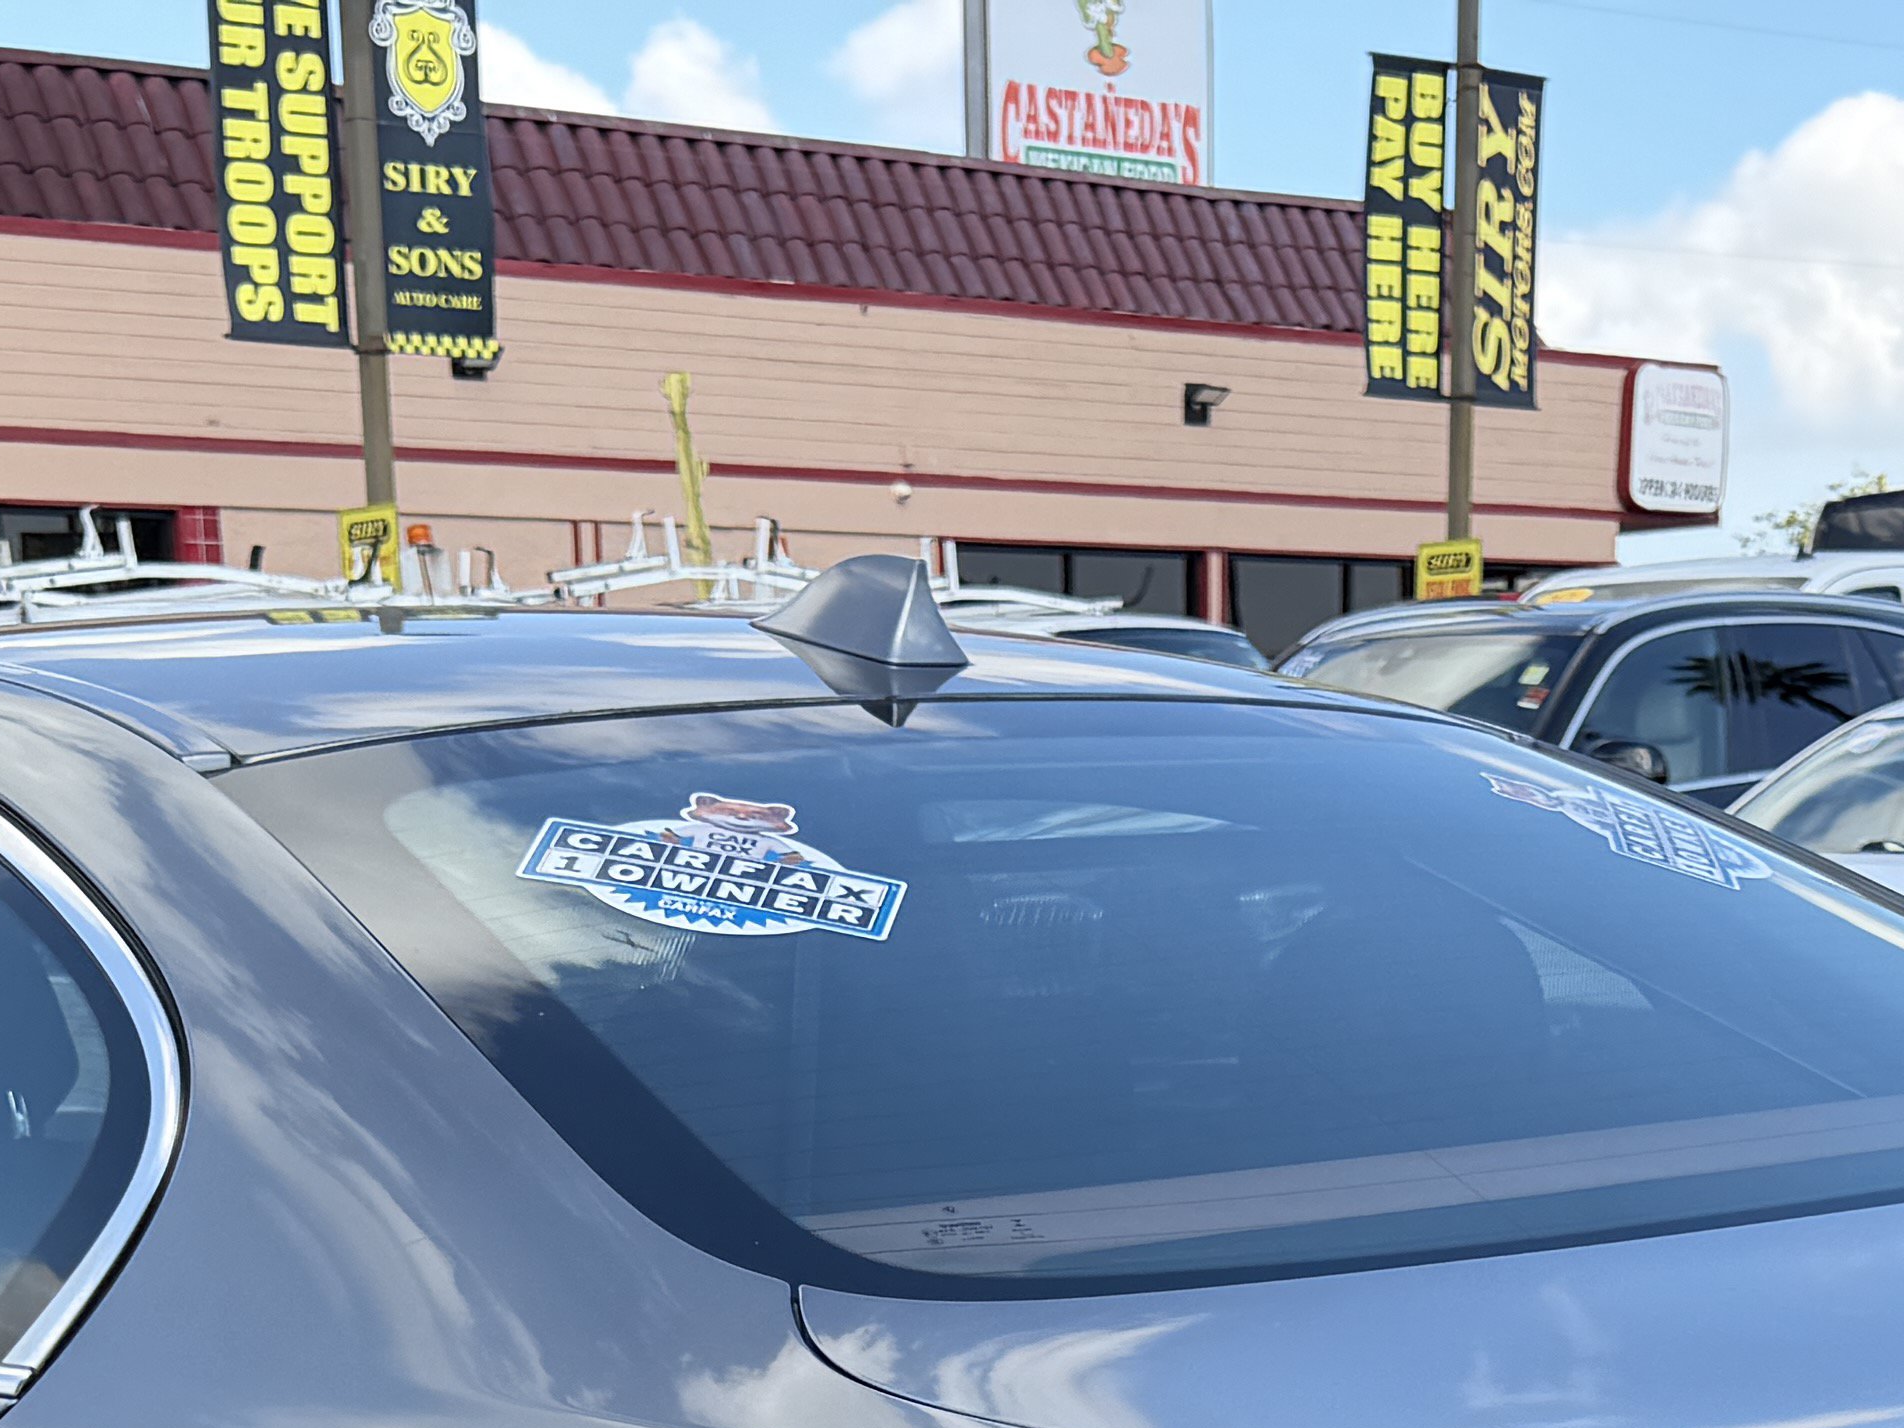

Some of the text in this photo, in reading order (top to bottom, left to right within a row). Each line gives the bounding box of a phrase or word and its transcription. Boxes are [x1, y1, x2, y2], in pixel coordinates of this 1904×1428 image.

[221, 81, 285, 322] TROOPS
[275, 50, 340, 333] SUPPORT
[383, 161, 477, 197] SIRY
[416, 206, 450, 234] &
[1367, 75, 1408, 380] PAY HERE
[1405, 73, 1444, 389] BUY HERE
[1472, 82, 1516, 392] SIRY
[388, 245, 483, 280] SONS
[553, 855, 584, 874] 1
[607, 863, 864, 926] OWNER
[566, 831, 877, 905] CARFAX
